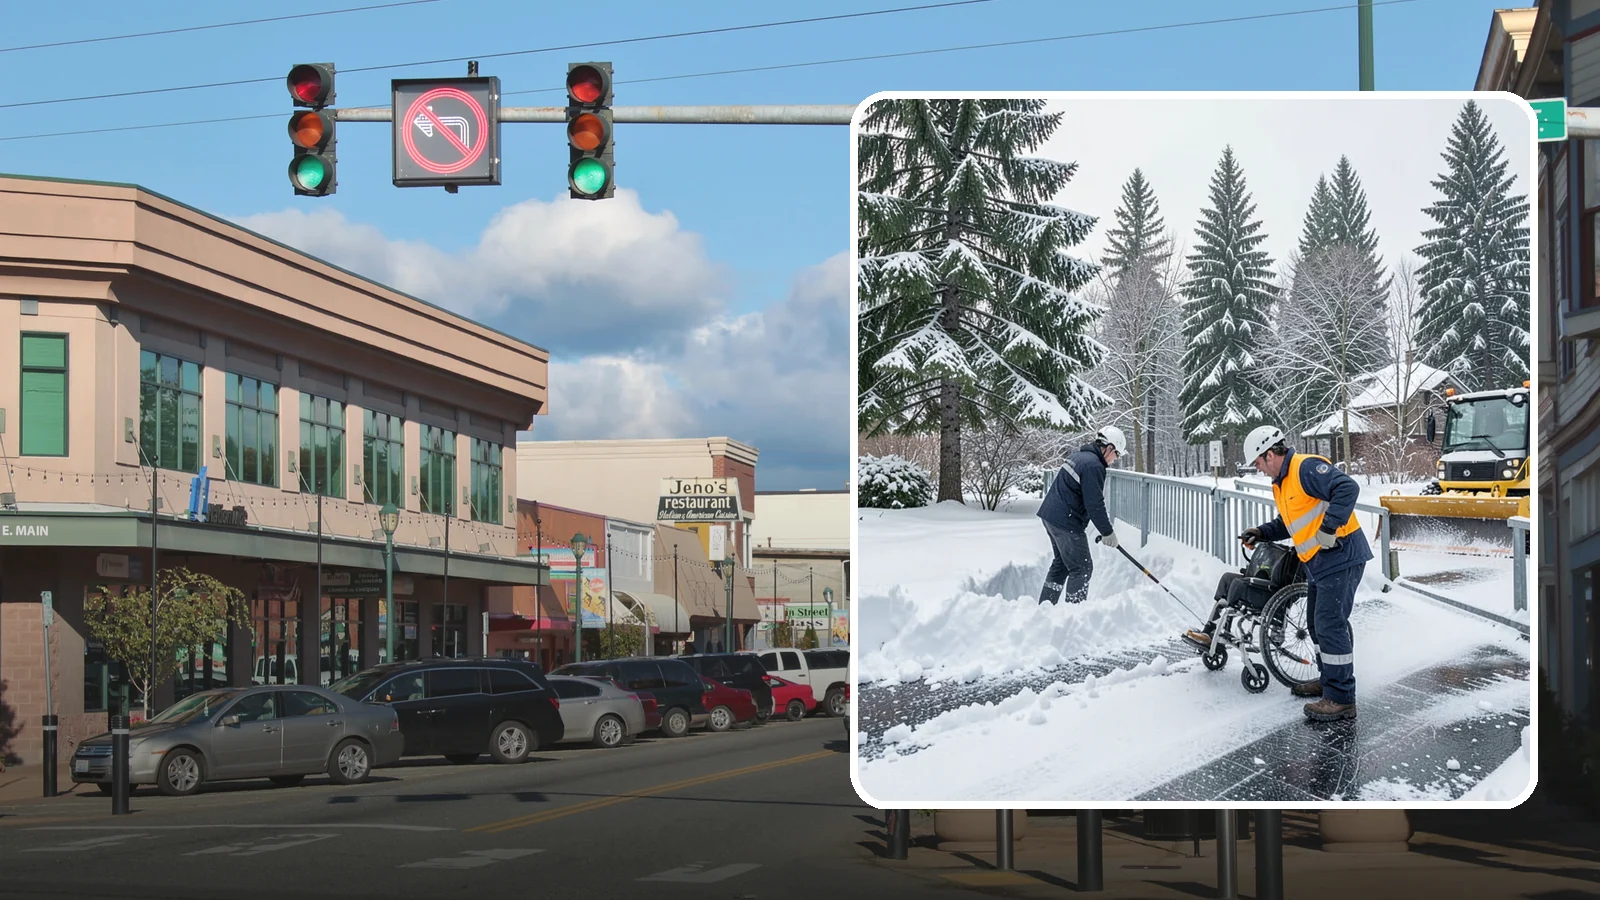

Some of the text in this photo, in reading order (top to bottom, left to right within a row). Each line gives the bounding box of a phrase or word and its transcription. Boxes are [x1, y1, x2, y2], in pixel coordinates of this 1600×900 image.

[669, 480, 726, 494] Jeno's
[665, 496, 731, 509] restaurant
[658, 510, 681, 520] Italian
[685, 510, 714, 519] American
[714, 509, 738, 519] Cuisine
[2, 525, 49, 536] E. MAIN
[785, 607, 795, 617] in
[797, 607, 829, 617] Street
[791, 619, 824, 627] lass
